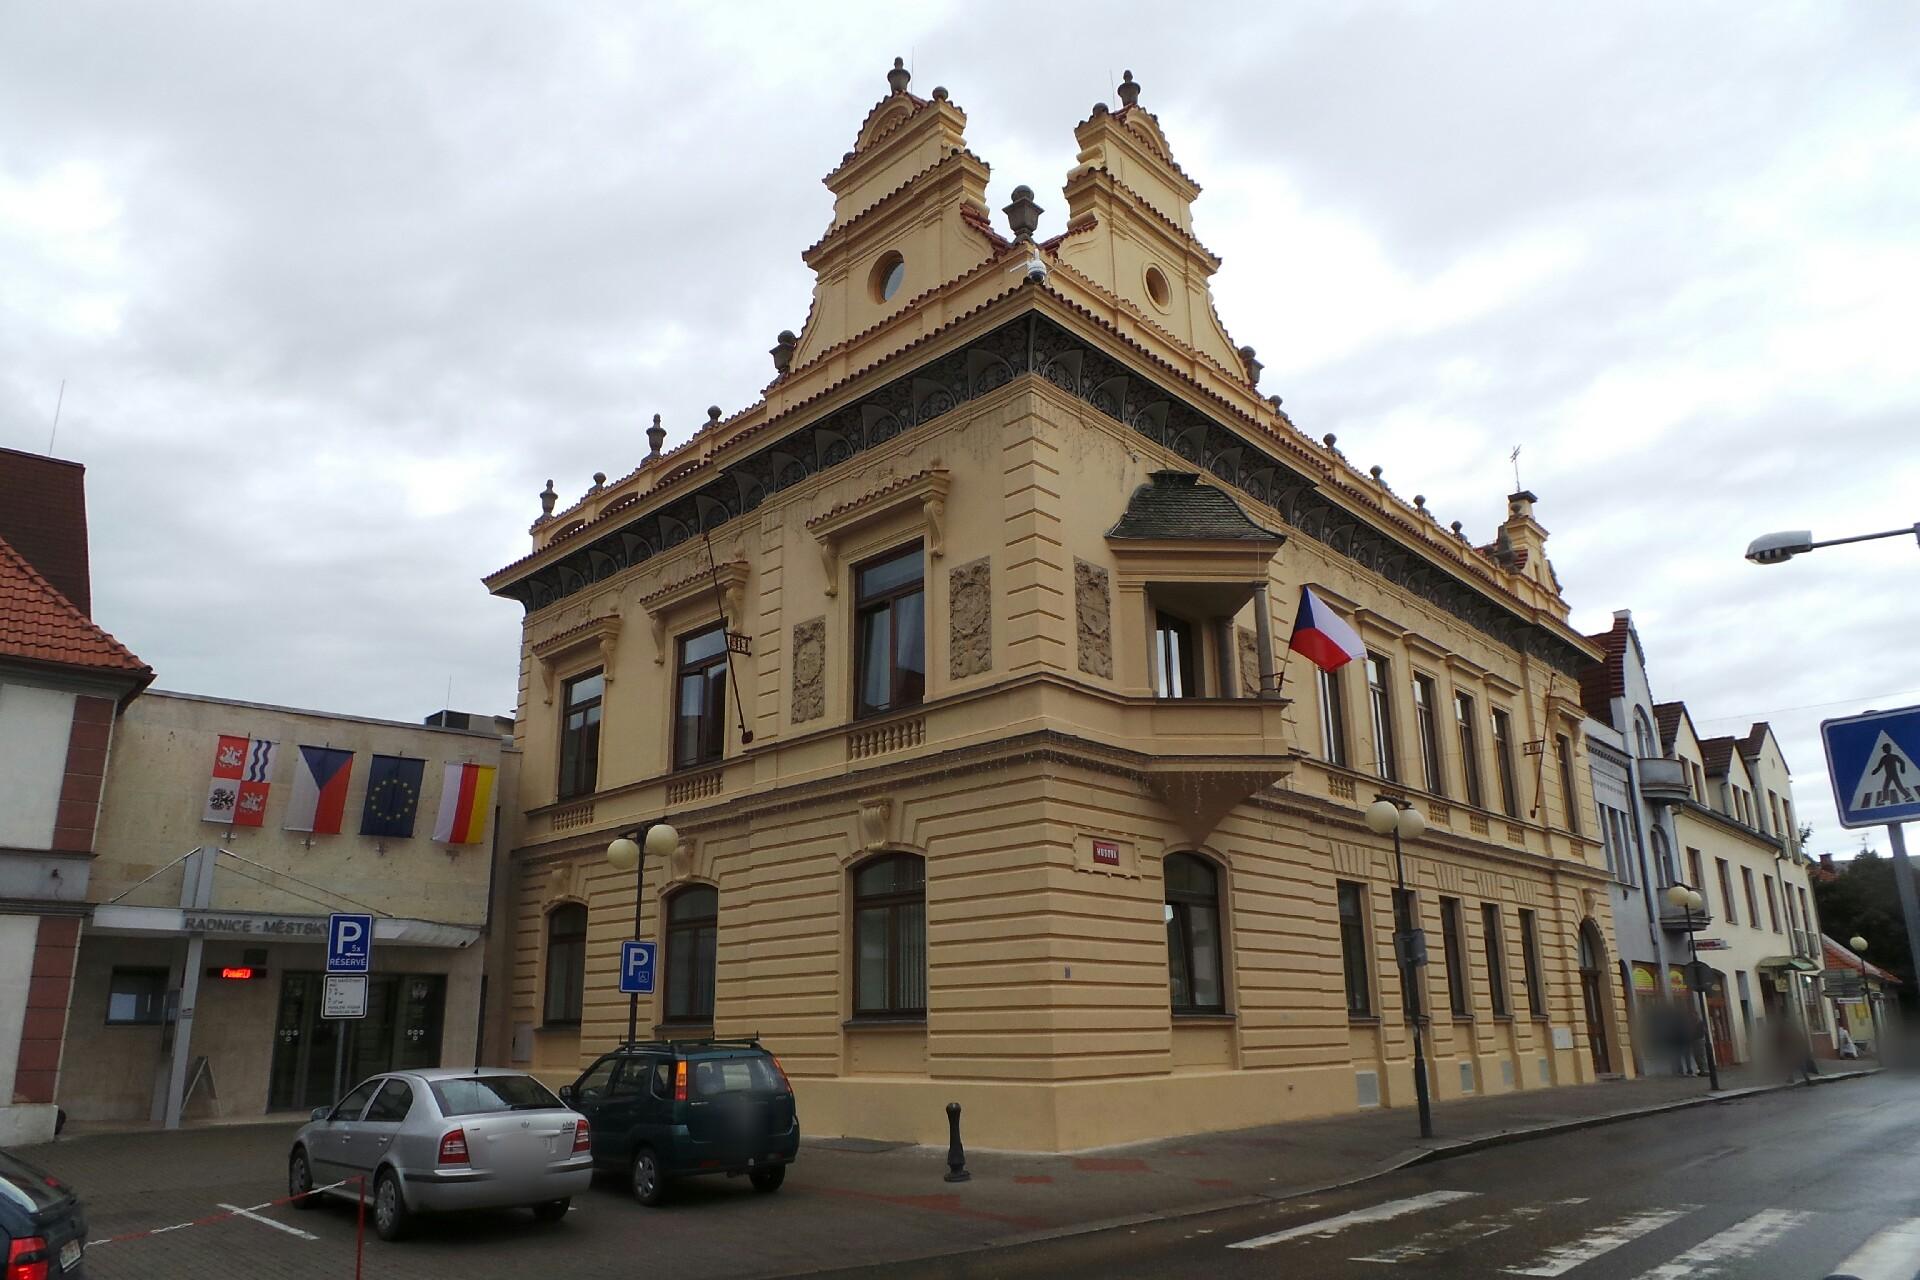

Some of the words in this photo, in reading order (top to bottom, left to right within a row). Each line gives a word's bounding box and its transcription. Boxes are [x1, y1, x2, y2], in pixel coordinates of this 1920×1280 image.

[184, 917, 252, 933] RADNICE
[337, 921, 362, 954] P
[628, 947, 649, 977] P
